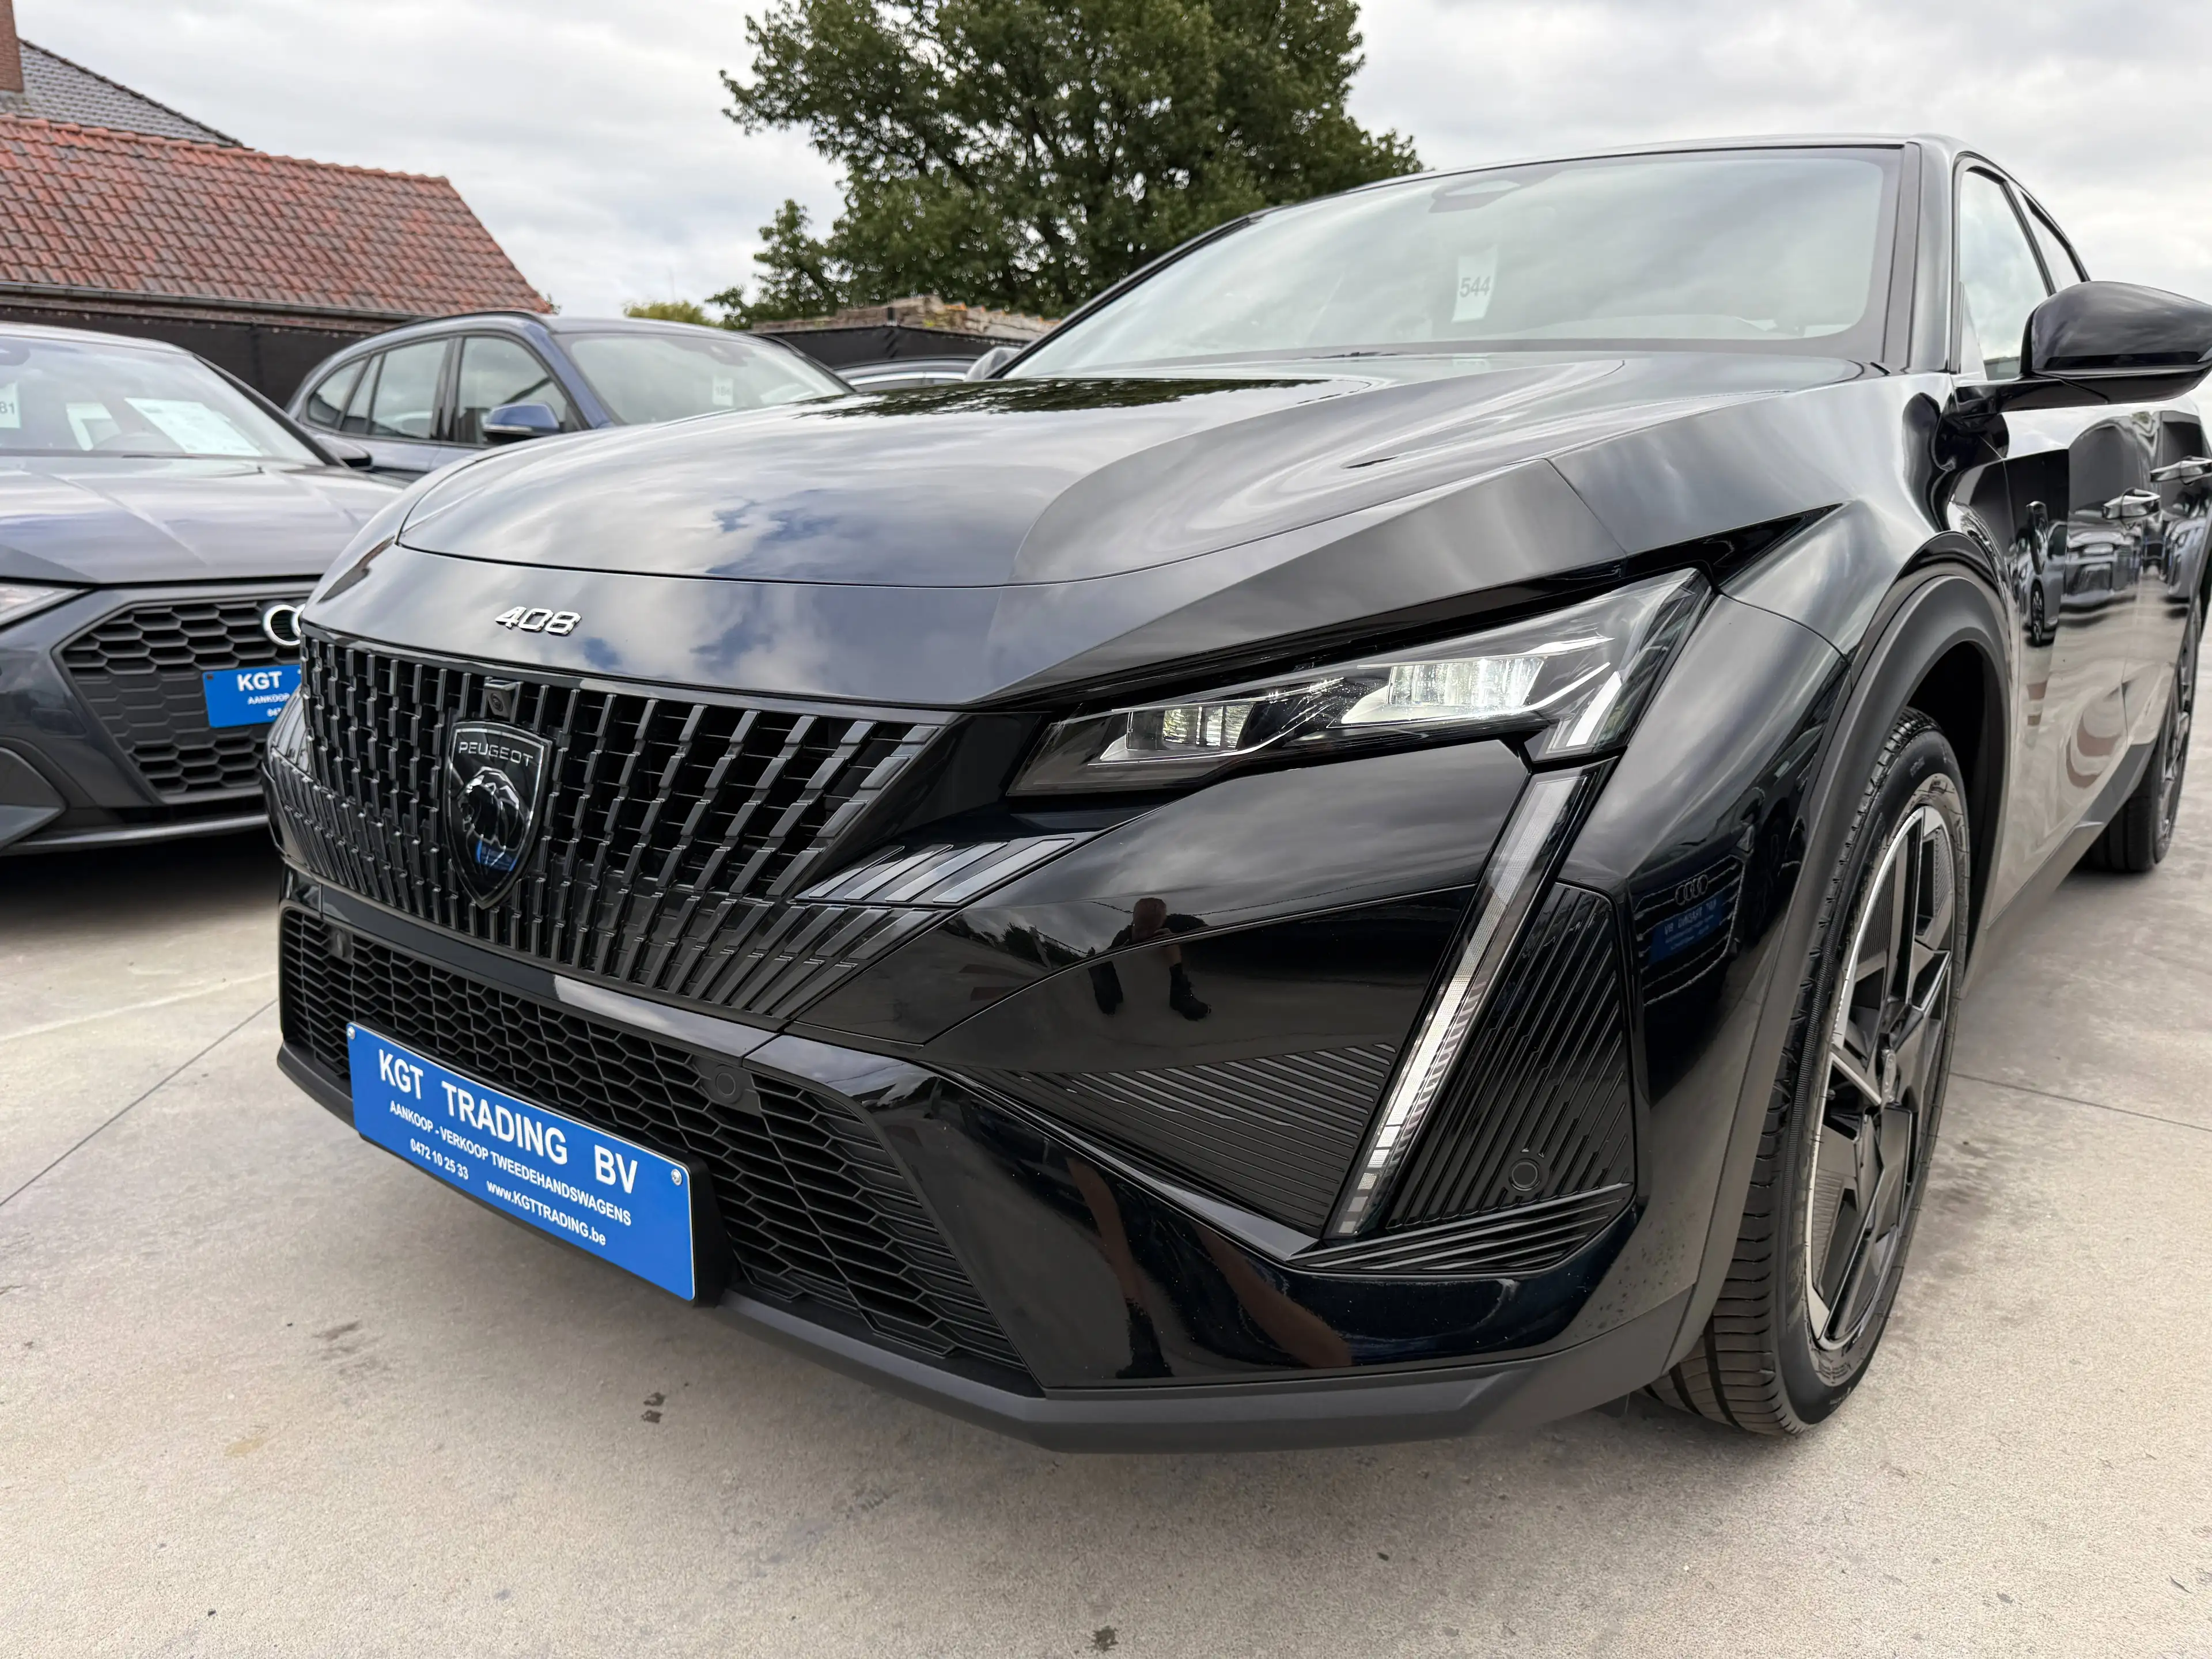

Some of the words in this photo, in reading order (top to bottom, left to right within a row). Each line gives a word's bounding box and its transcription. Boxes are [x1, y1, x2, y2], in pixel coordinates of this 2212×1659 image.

[1459, 275, 1491, 298] 544
[495, 607, 582, 635] 408
[237, 671, 282, 692] KGT
[458, 742, 533, 767] PEUGEOT
[378, 1048, 424, 1100] KGT
[441, 1080, 568, 1165] TRADING
[594, 1144, 638, 1194] BV
[389, 1100, 434, 1134] AANKOOP
[490, 1151, 632, 1226] TWEEDEHANDSWAGENS
[410, 1138, 431, 1160] 0472
[432, 1150, 444, 1167] 10
[444, 1156, 456, 1173] 25
[457, 1163, 469, 1180] 33
[486, 1180, 607, 1246] www.KGTTRADING.be
